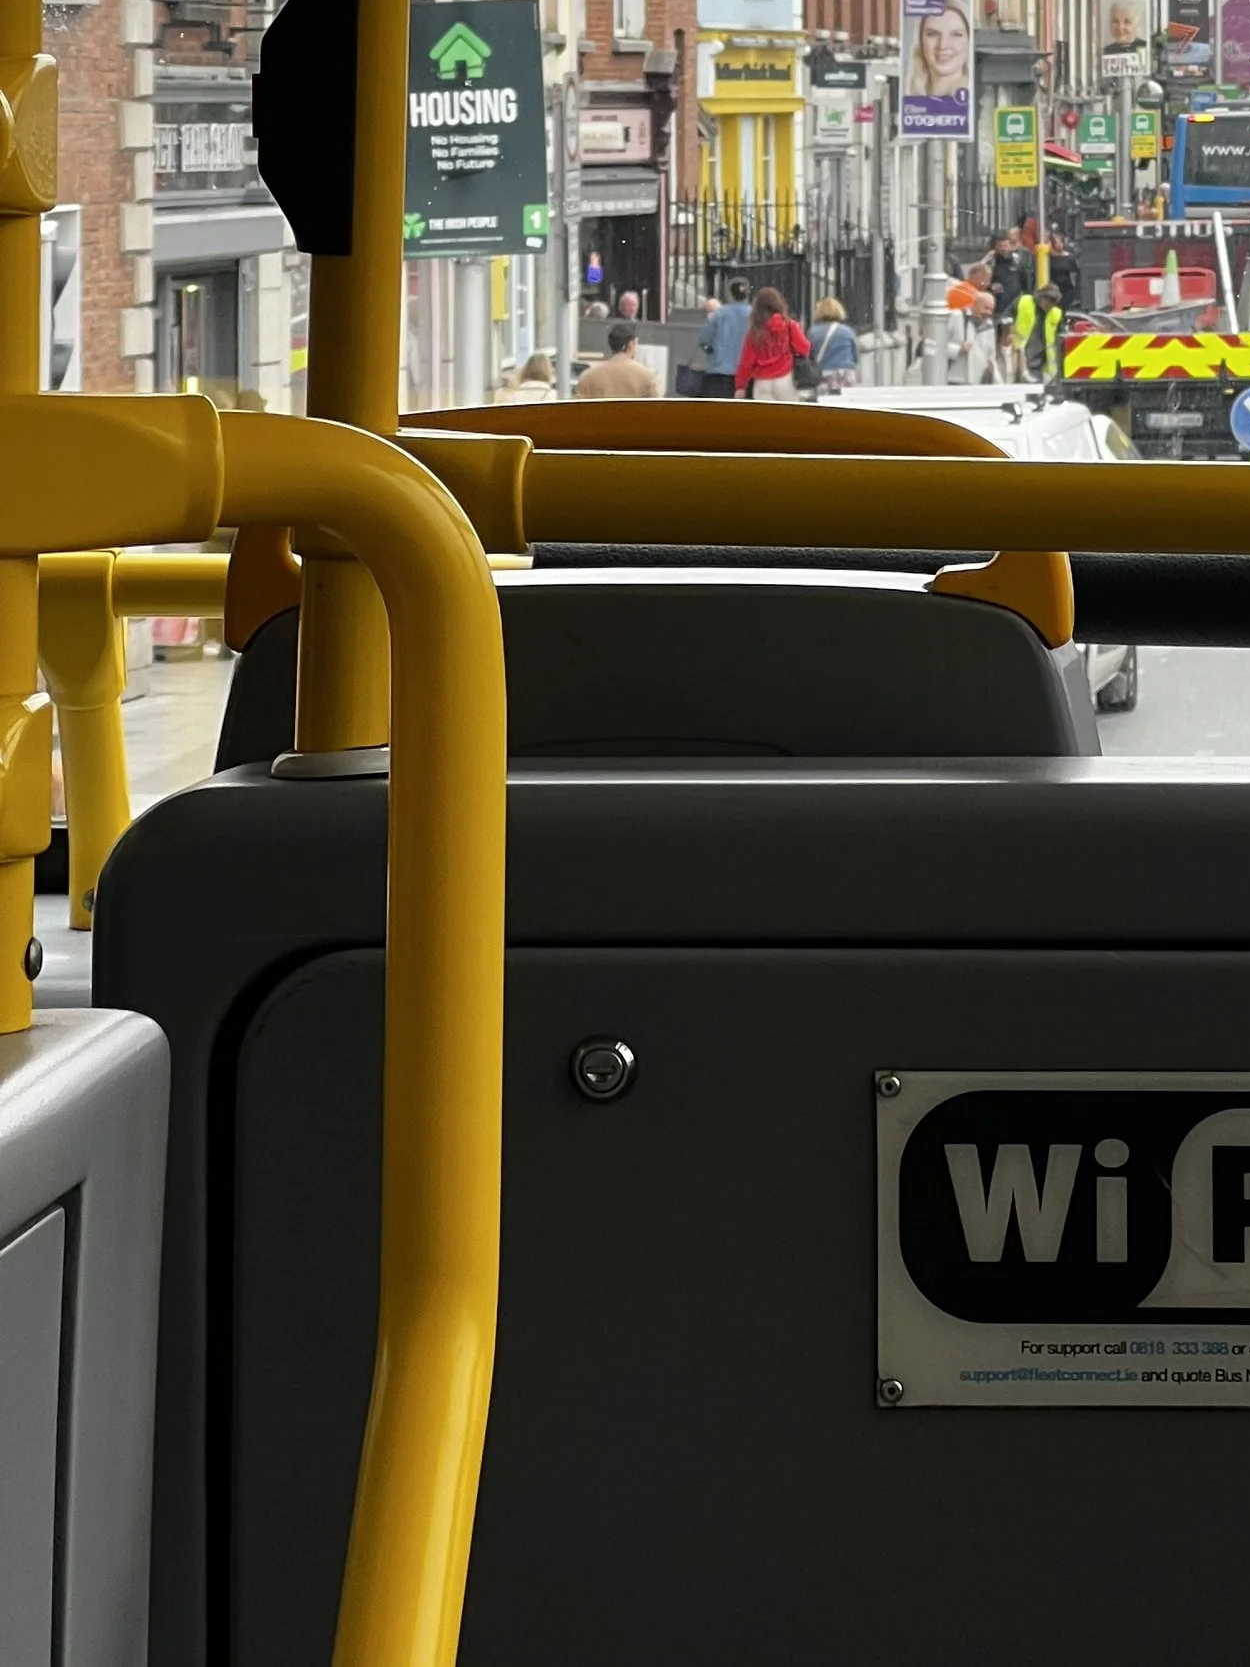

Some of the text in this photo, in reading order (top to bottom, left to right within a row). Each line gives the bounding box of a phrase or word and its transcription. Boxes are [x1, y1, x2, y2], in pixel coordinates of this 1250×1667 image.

[959, 90, 967, 102] 1
[409, 87, 518, 128] HOUSING
[903, 114, 967, 128] O'DOHERTY
[430, 133, 500, 146] No Housing
[431, 145, 501, 159] No Families
[436, 159, 496, 171] No Future
[428, 218, 444, 231] THE
[467, 216, 499, 229] PEOPLE
[530, 210, 542, 229] 1
[943, 1137, 1130, 1264] Wi
[1020, 1340, 1044, 1355] For
[1047, 1342, 1101, 1359] support
[1103, 1340, 1128, 1355] call
[1129, 1341, 1165, 1355] 0818
[1171, 1342, 1200, 1355] 333
[1231, 1344, 1247, 1356] or
[959, 1367, 1138, 1384] support@fleetconnect.ie
[1140, 1367, 1169, 1383] and
[1171, 1369, 1212, 1386] quote
[1214, 1368, 1244, 1384] Bus
